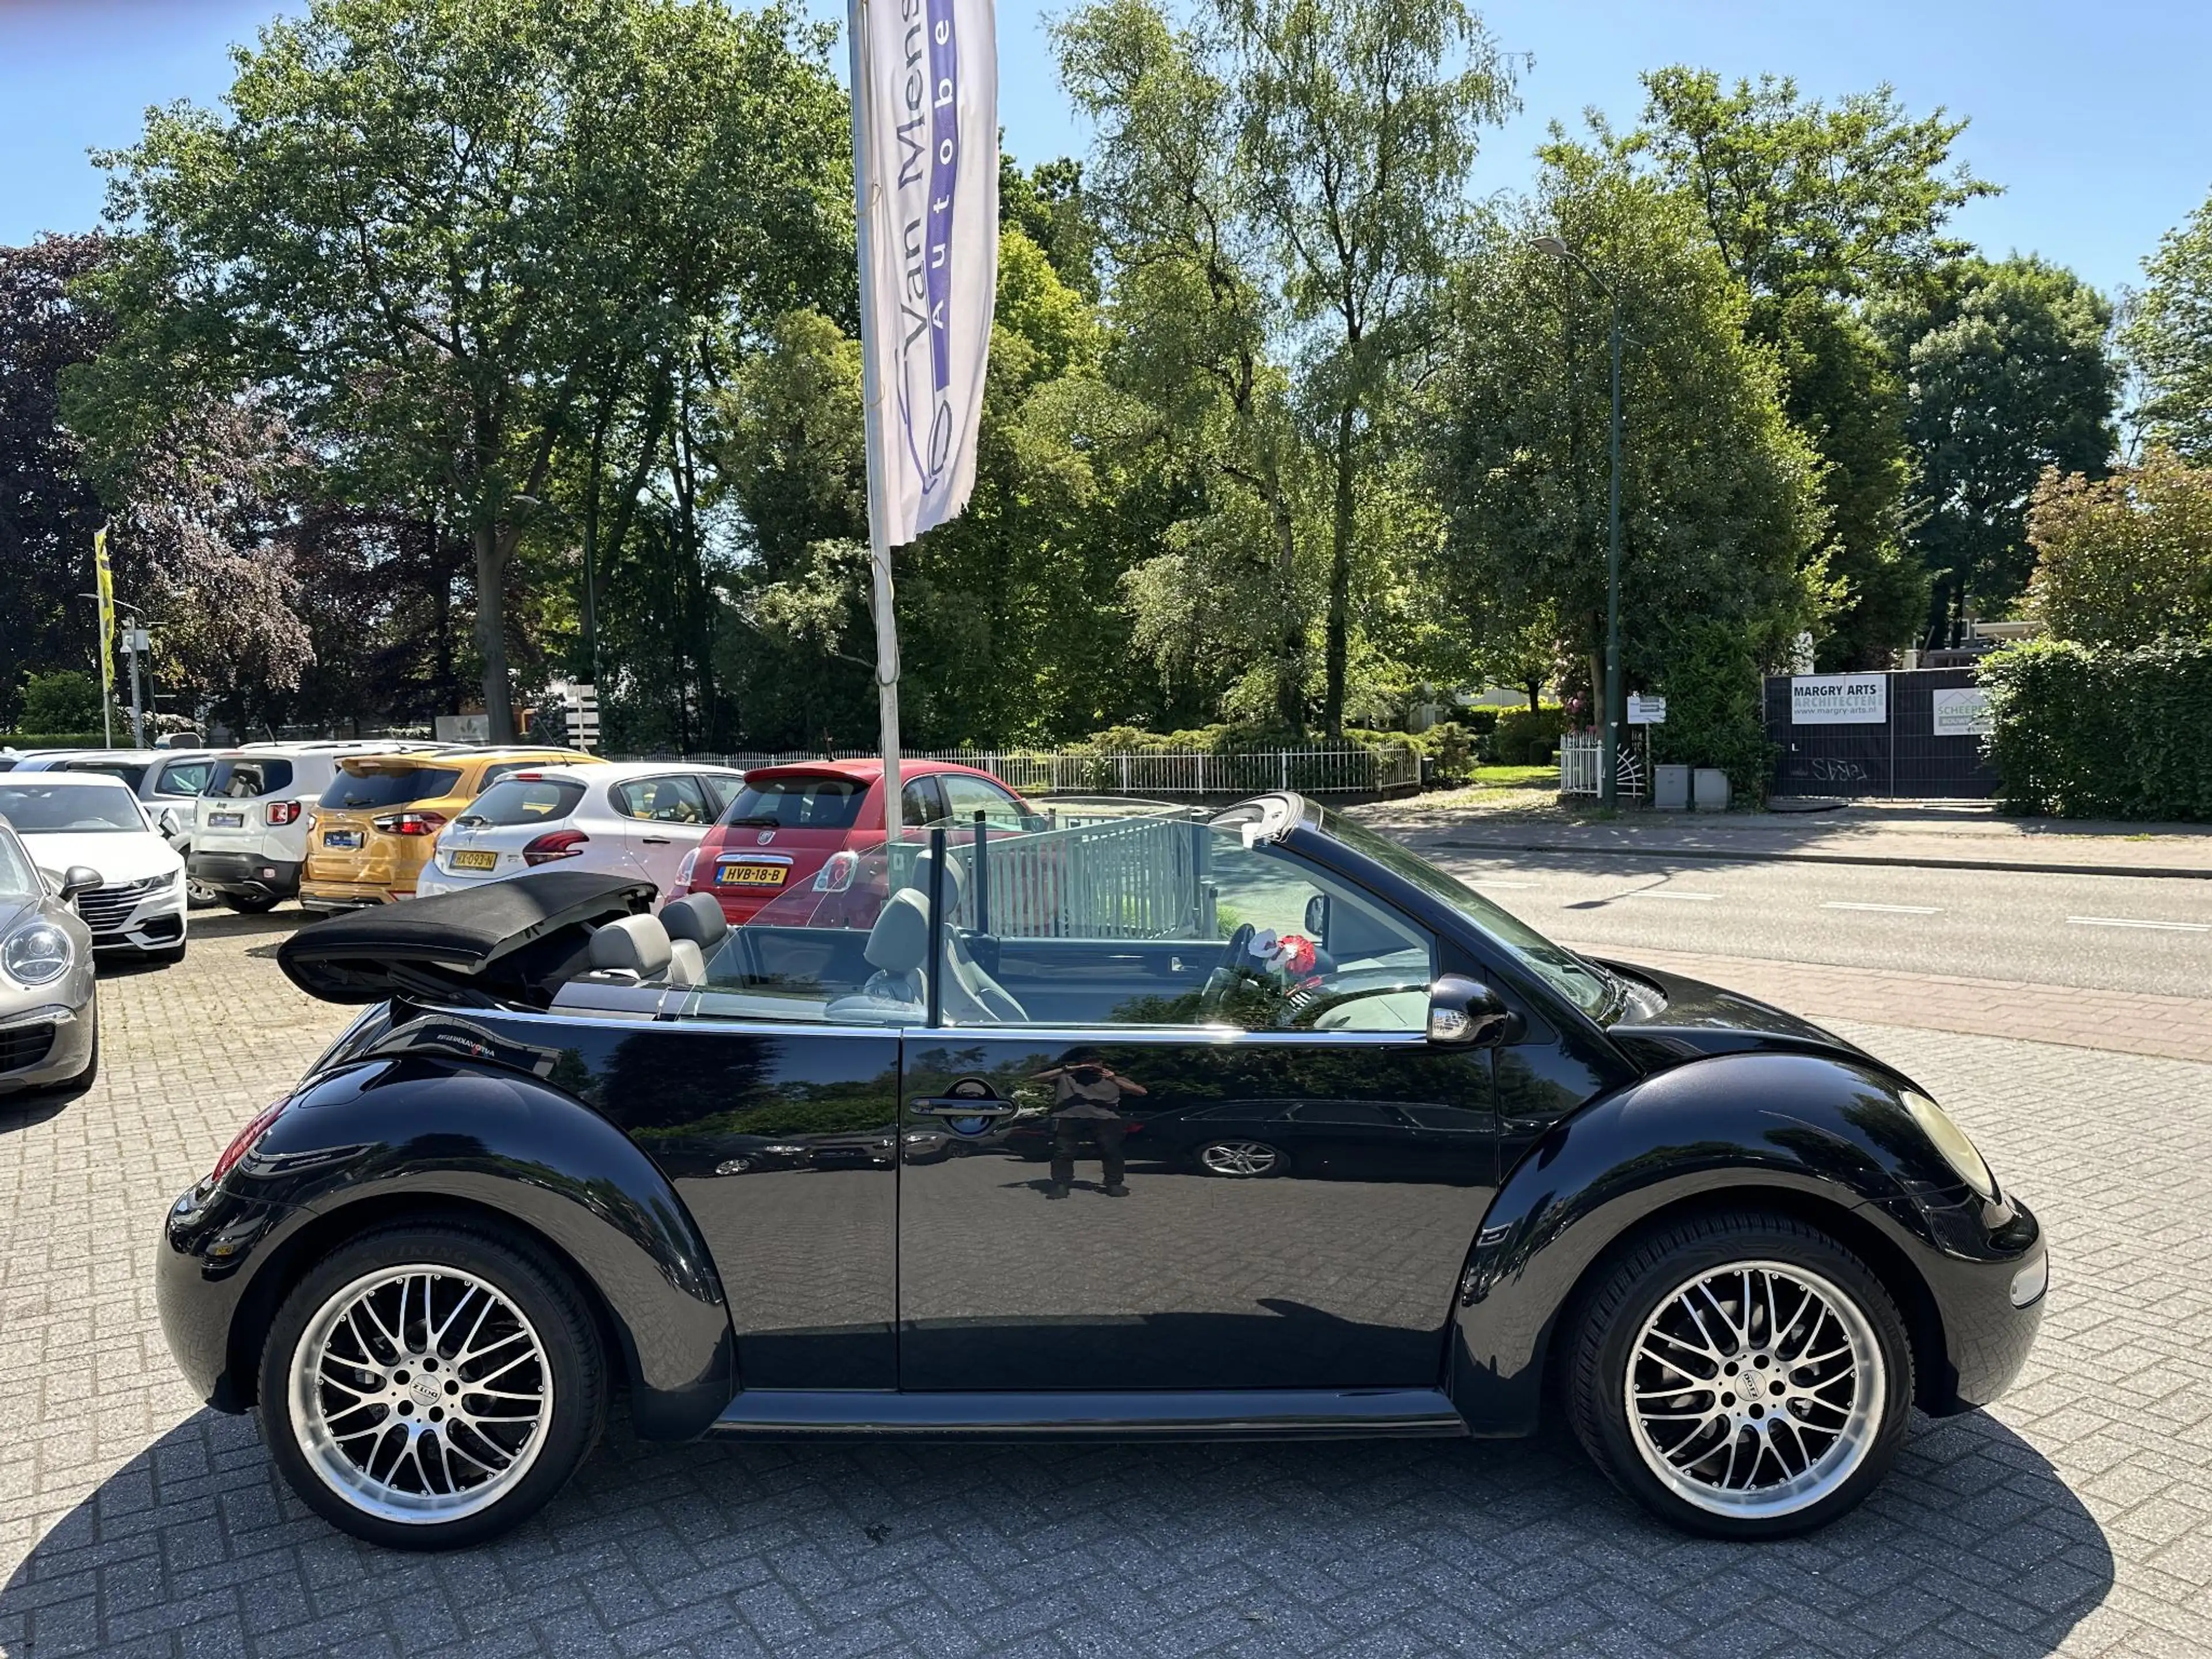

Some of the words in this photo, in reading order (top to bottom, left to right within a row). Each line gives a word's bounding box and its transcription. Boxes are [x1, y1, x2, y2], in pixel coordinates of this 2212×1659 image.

[900, 217, 927, 360] Van
[1794, 685, 1843, 696] MARGRY
[1847, 684, 1876, 695] ARTS
[1794, 696, 1876, 707] ARCHITECTEN
[1794, 707, 1876, 715] www.margry-arts.nl
[456, 853, 494, 865] HX-093-N
[727, 868, 781, 881] HVB-18-B
